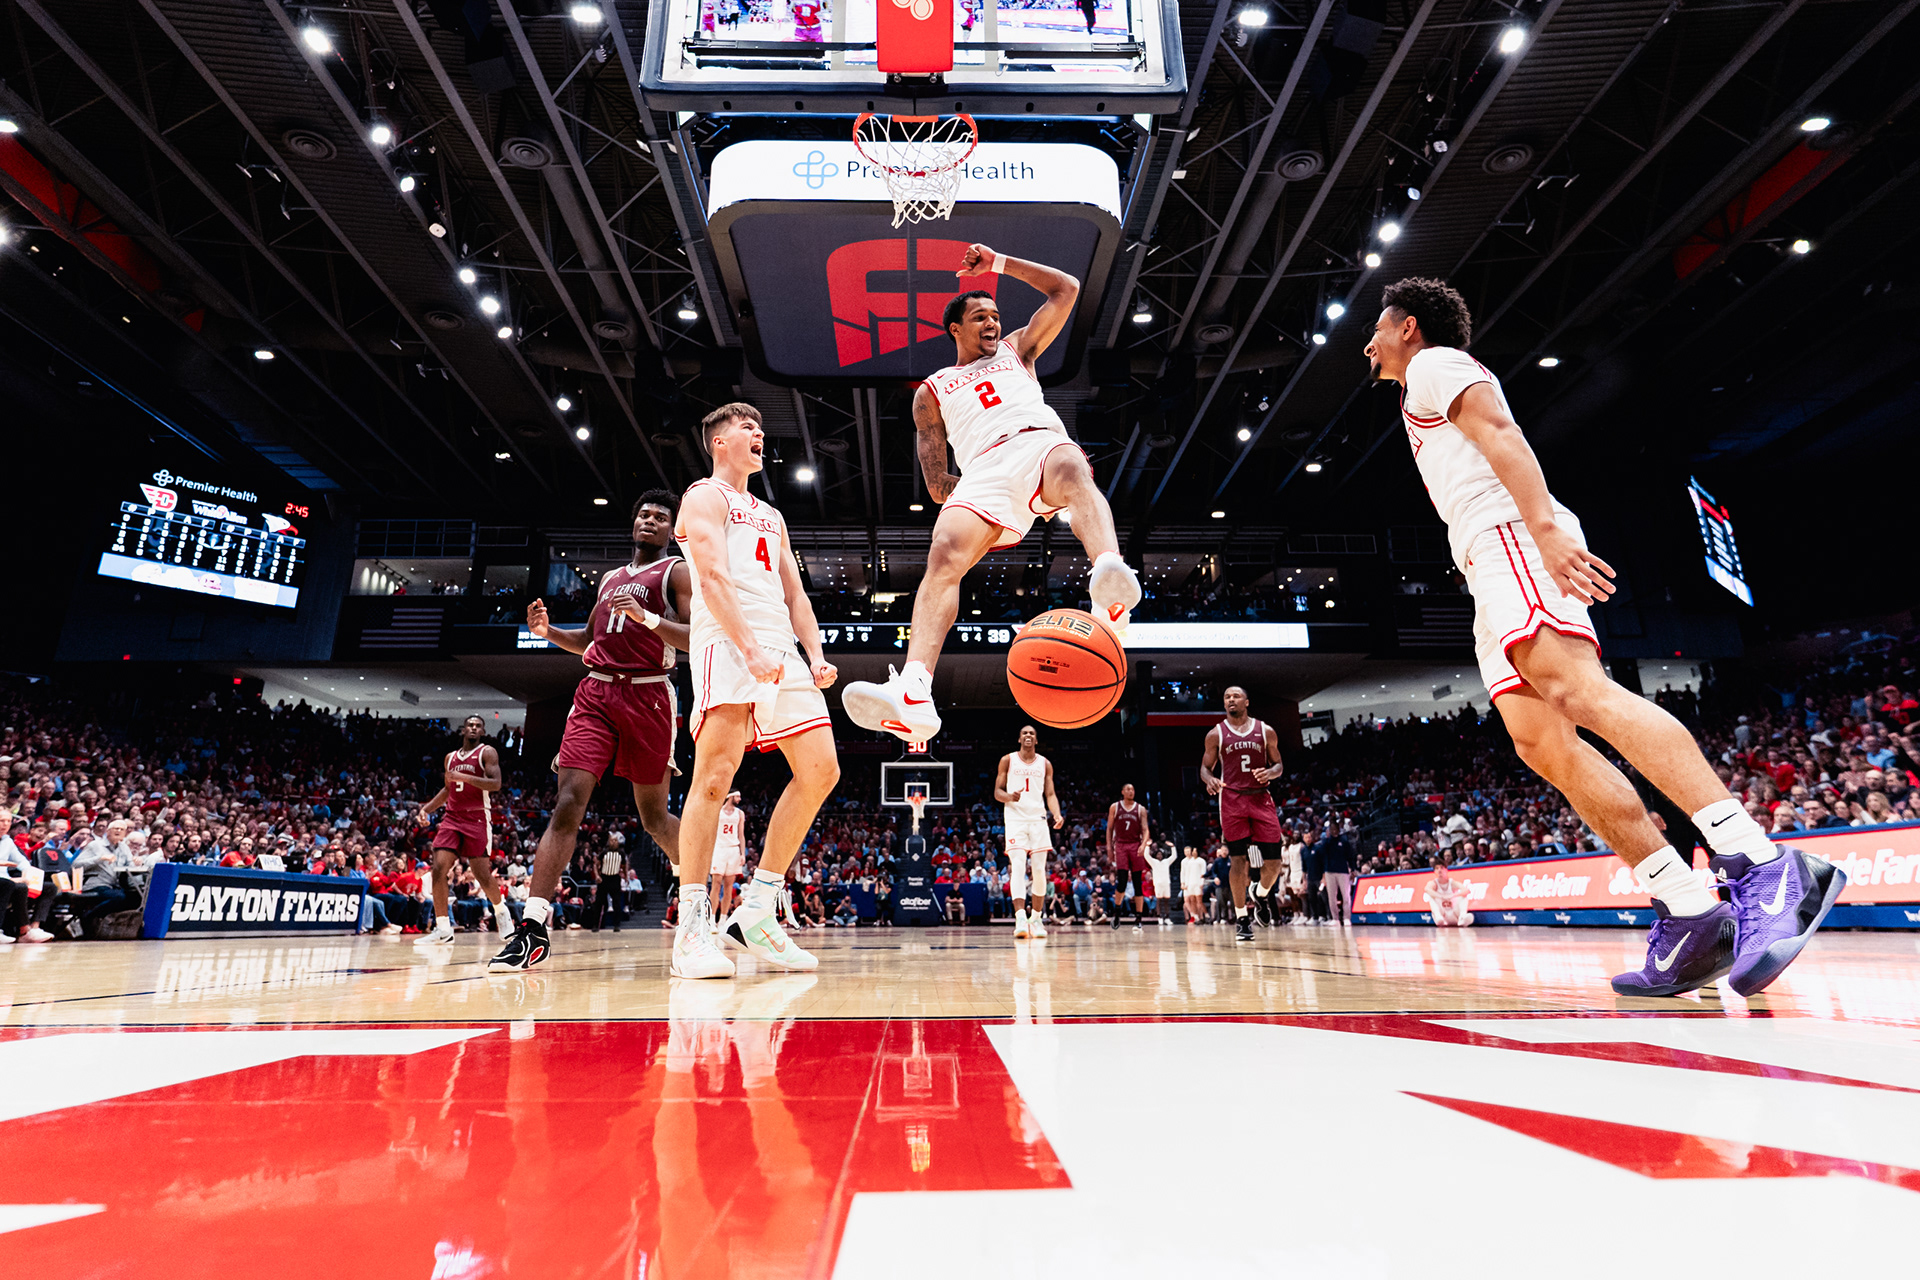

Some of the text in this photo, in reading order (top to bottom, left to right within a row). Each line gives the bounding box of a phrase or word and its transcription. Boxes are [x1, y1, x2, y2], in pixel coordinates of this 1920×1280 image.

[960, 161, 1034, 179] Health
[944, 360, 1013, 394] DAYTON
[974, 381, 1002, 409] 2
[175, 476, 258, 503] Premier Health
[285, 502, 309, 518] 2:45
[755, 537, 772, 572] 4
[614, 583, 649, 602] CENTRAL
[1031, 615, 1095, 637] ELITE
[819, 629, 839, 644] 17
[847, 633, 869, 642] 3 6
[974, 633, 982, 642] 4
[1219, 633, 1248, 642] Dayton
[1241, 754, 1251, 772] 2
[1025, 778, 1029, 792] 1
[723, 824, 733, 835] 24
[1125, 820, 1131, 831] 7
[171, 884, 360, 922] DAYTON FLYERS
